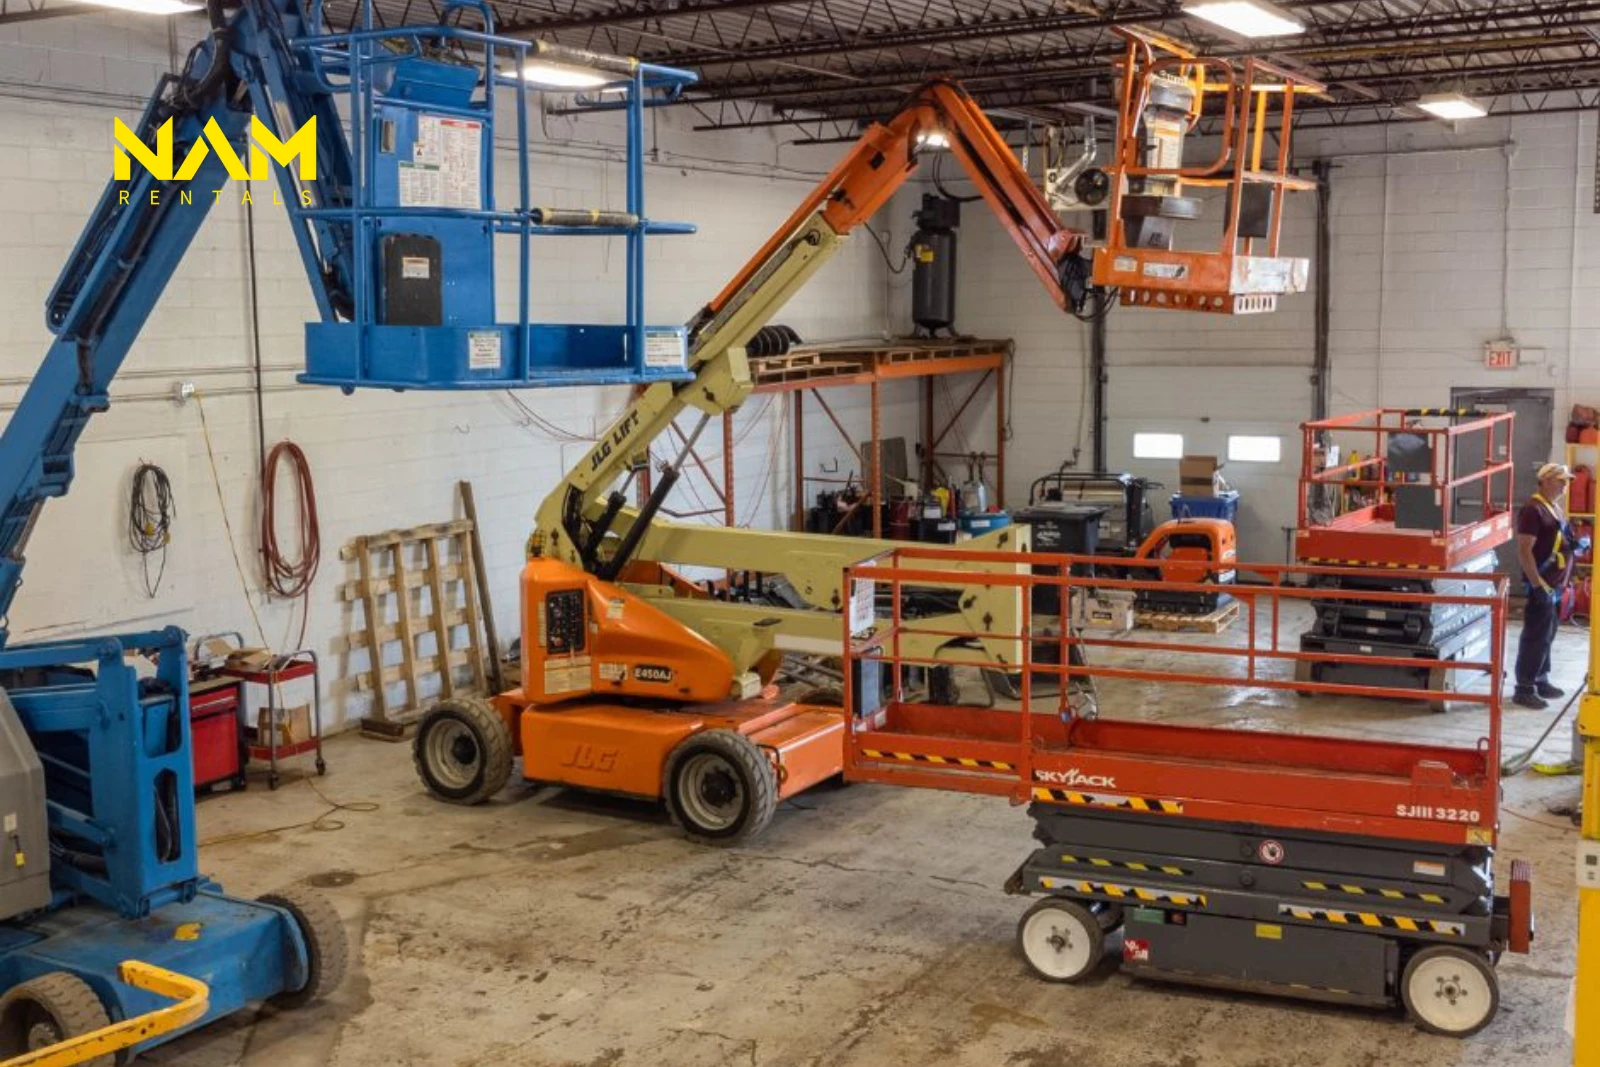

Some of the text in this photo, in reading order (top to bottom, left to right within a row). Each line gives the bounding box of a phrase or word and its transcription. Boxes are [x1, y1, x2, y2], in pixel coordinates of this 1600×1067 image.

[1489, 351, 1512, 367] EXIT
[591, 409, 639, 472] JLG LIFT
[634, 667, 672, 680] E450AJ
[560, 744, 620, 773] JLG
[1034, 767, 1117, 788] SKYJACK
[1435, 807, 1480, 822] 3220
